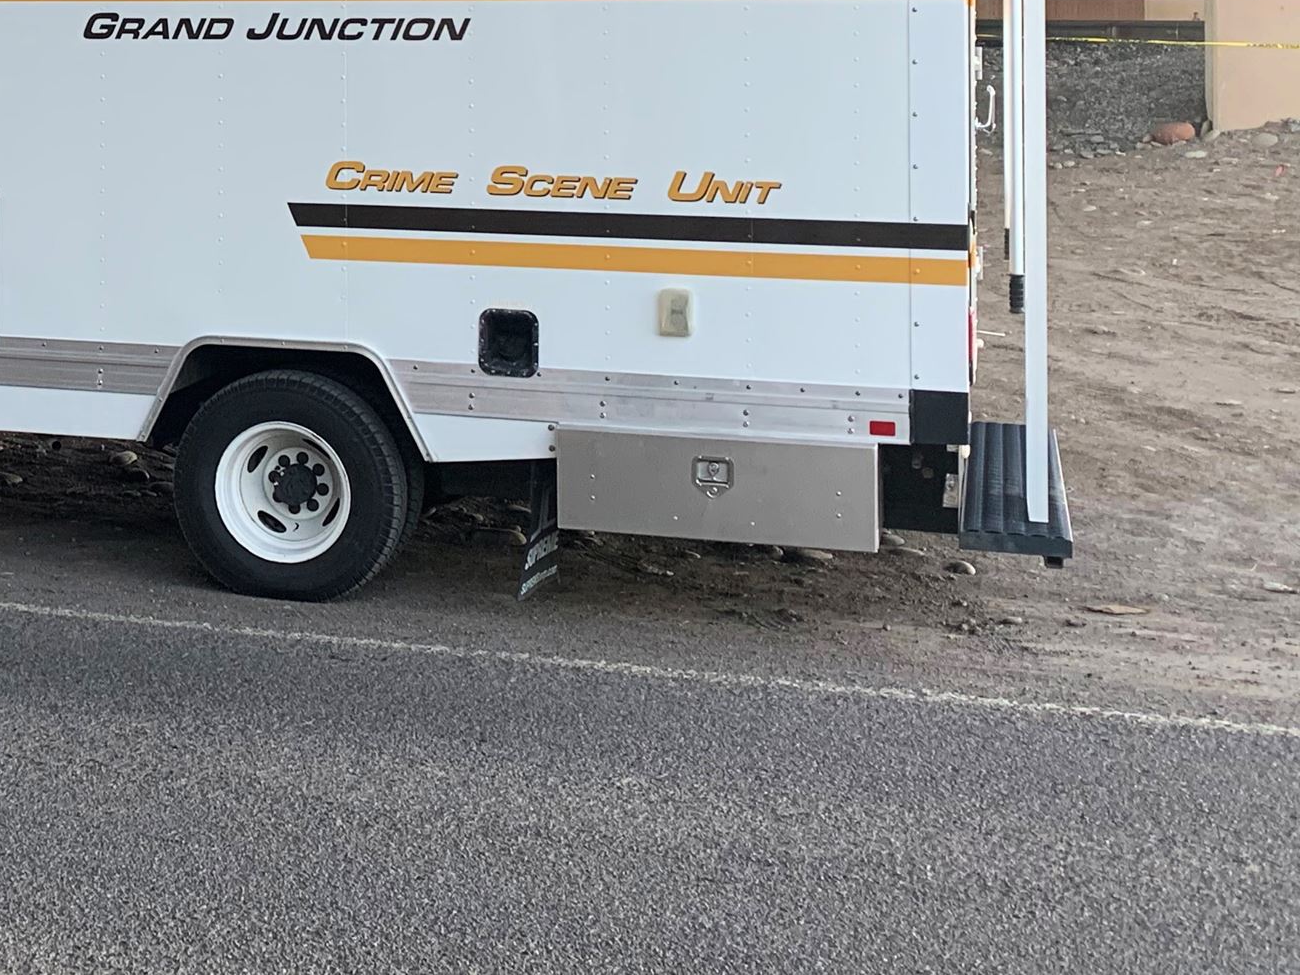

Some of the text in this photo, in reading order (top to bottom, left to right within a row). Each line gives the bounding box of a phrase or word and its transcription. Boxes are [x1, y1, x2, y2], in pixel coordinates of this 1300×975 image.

[83, 12, 471, 41] GRAND JUNCTION
[325, 160, 782, 204] CRIME SCENE UNIT
